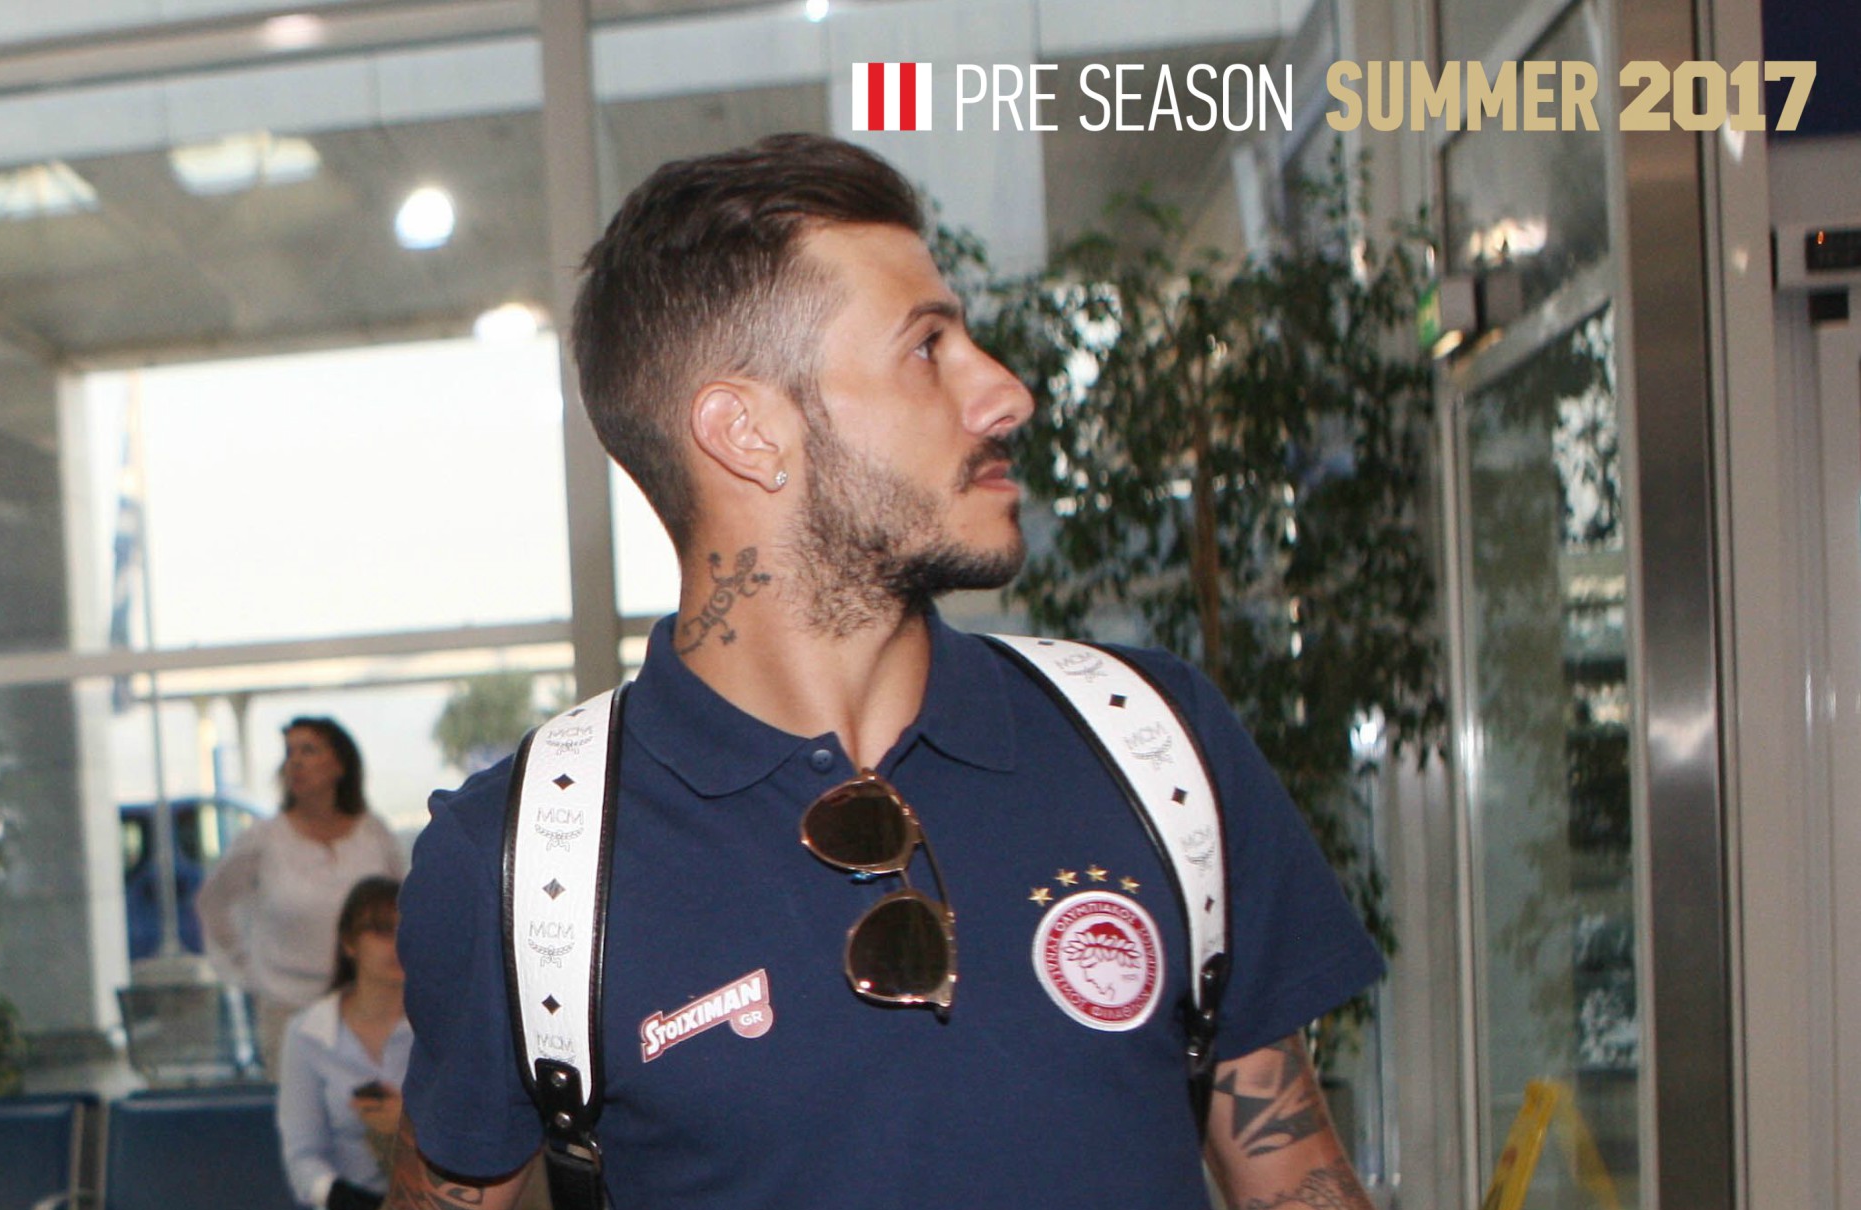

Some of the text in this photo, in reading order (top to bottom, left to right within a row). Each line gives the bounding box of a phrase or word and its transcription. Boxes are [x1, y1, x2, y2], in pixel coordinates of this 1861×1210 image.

[547, 725, 594, 739] MCM
[536, 807, 585, 825] MCM
[529, 920, 575, 939] MCM
[739, 1010, 764, 1026] GR
